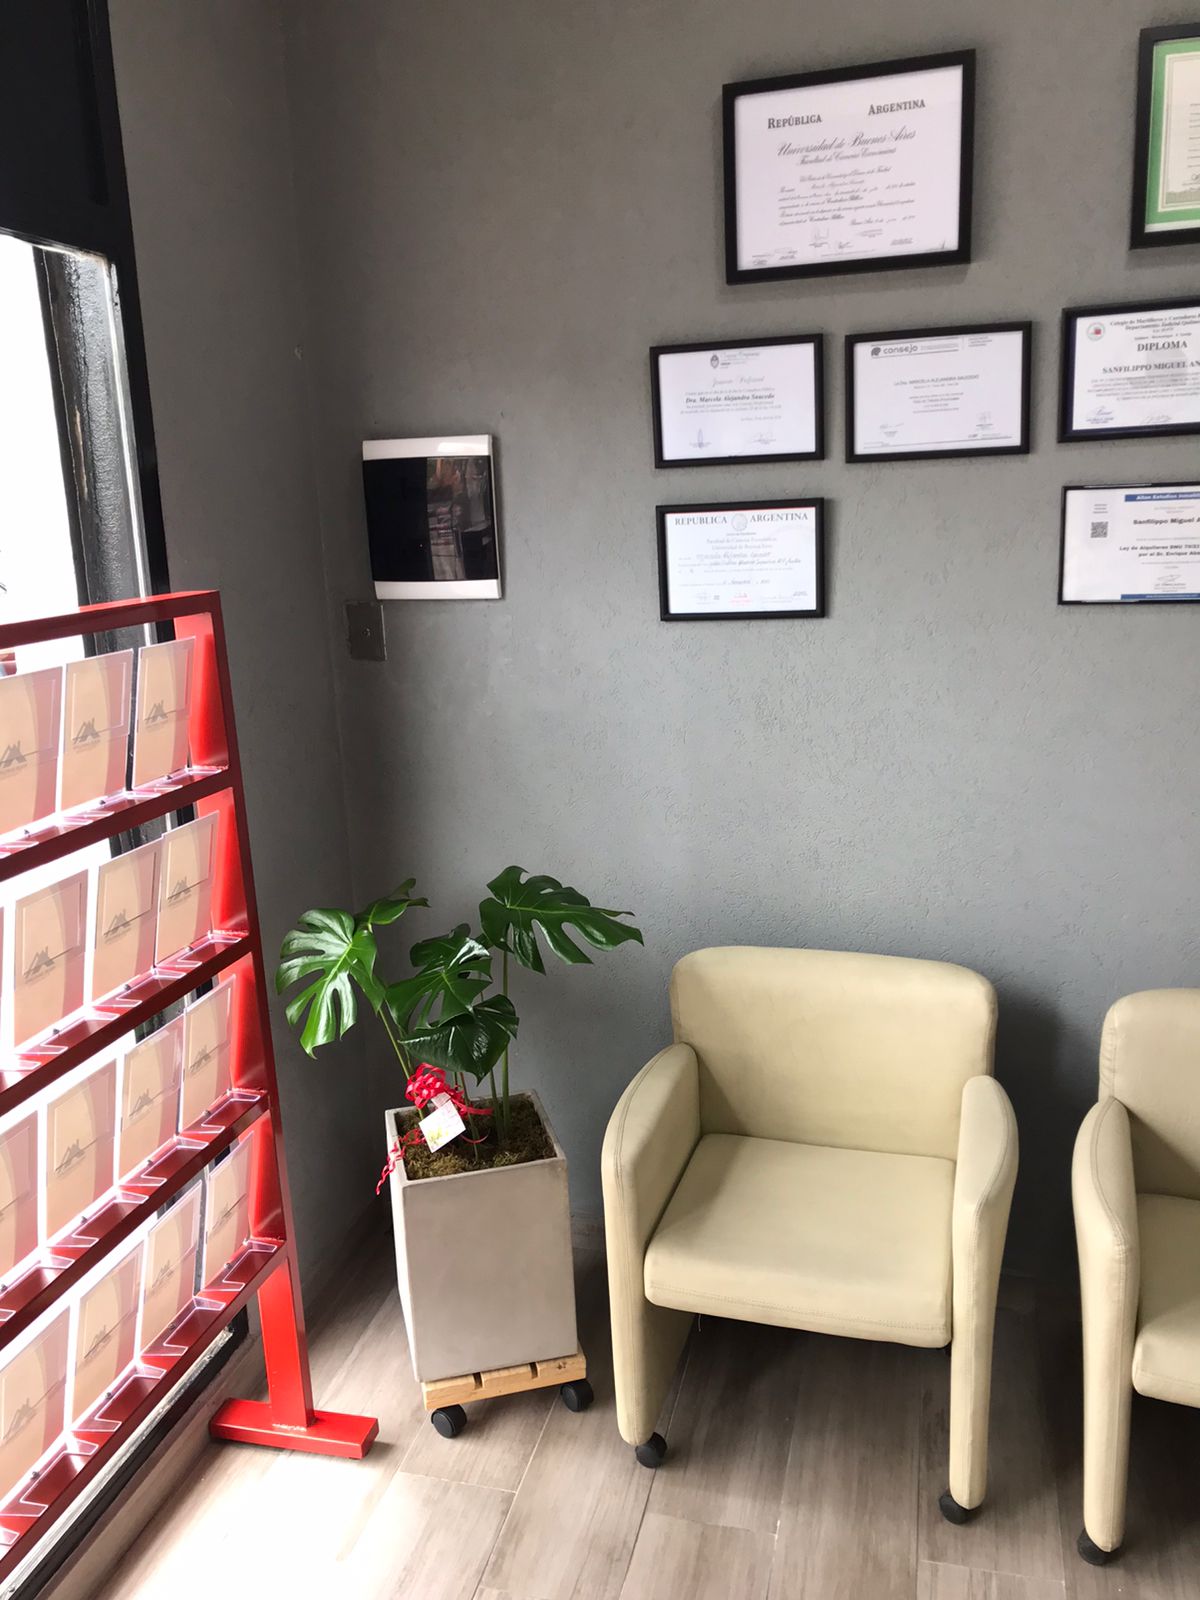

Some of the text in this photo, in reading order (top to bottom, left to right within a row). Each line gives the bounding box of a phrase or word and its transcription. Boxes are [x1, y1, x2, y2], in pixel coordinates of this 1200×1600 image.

[868, 99, 926, 116] ARGENTINA
[883, 344, 918, 355] consejo
[1137, 340, 1188, 352] DIPLOMA
[1102, 364, 1152, 375] SANFILIPPO
[1154, 361, 1188, 371] MIGUEL
[750, 513, 808, 523] ARGENTINA
[1170, 517, 1195, 525] Miguel
